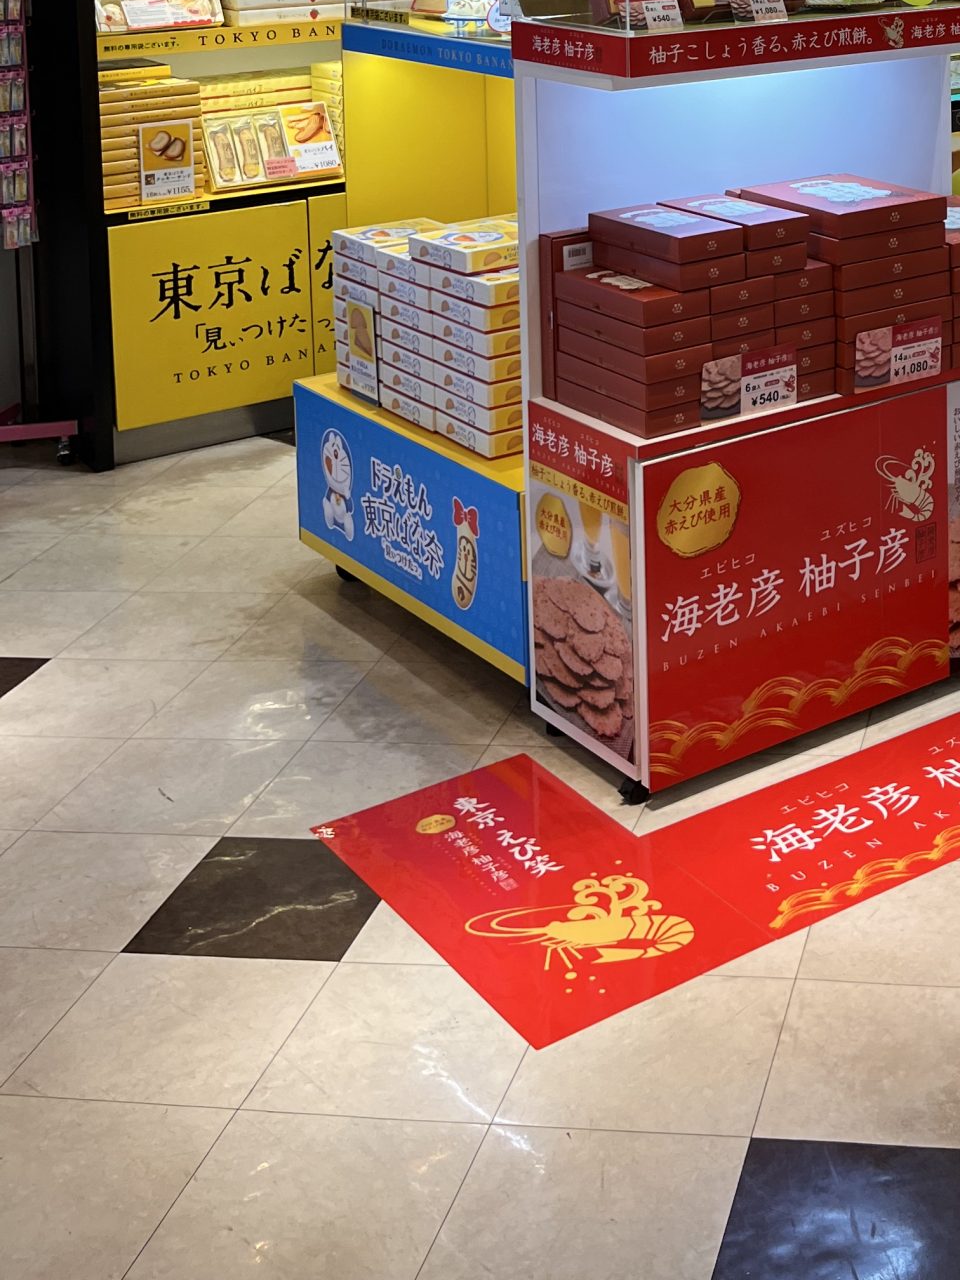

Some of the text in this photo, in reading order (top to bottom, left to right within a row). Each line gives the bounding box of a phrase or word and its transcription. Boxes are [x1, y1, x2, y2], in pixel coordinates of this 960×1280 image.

[103, 40, 181, 53] 無料の専用袋ございます。
[198, 30, 277, 46] TOKYO
[531, 34, 595, 61] 海老彦 柚子彦
[648, 26, 874, 66] 柚子こしょう香る、赤えび煎餅。
[909, 21, 948, 41] 海老彦
[381, 38, 472, 64] DORAEMON TOKYO
[895, 326, 935, 341] 海老彦 柚子彦
[173, 360, 251, 384] TOKYO
[745, 354, 789, 371] 海老彦 柚子彦
[894, 360, 928, 378] ¥1,080
[751, 390, 779, 406] ¥540
[532, 422, 614, 477] 海老彦 柚子彦
[371, 456, 432, 520] ドラえもん
[667, 485, 729, 518] 大分県産
[361, 493, 444, 579] 東京ばな奈
[663, 505, 732, 537] 赤えび使用
[700, 516, 873, 579] エビヒコ ユズヒコ
[660, 527, 911, 644] 海老彦 柚子彦
[662, 571, 936, 672] BUZEN AKAEBI SENBEI
[780, 780, 850, 815] エビヒコ
[454, 796, 564, 878] 東京 えび笑
[748, 780, 921, 864] 海老彦
[446, 830, 510, 883] 海老彦 柚子彦
[766, 837, 882, 894] BUZEN
